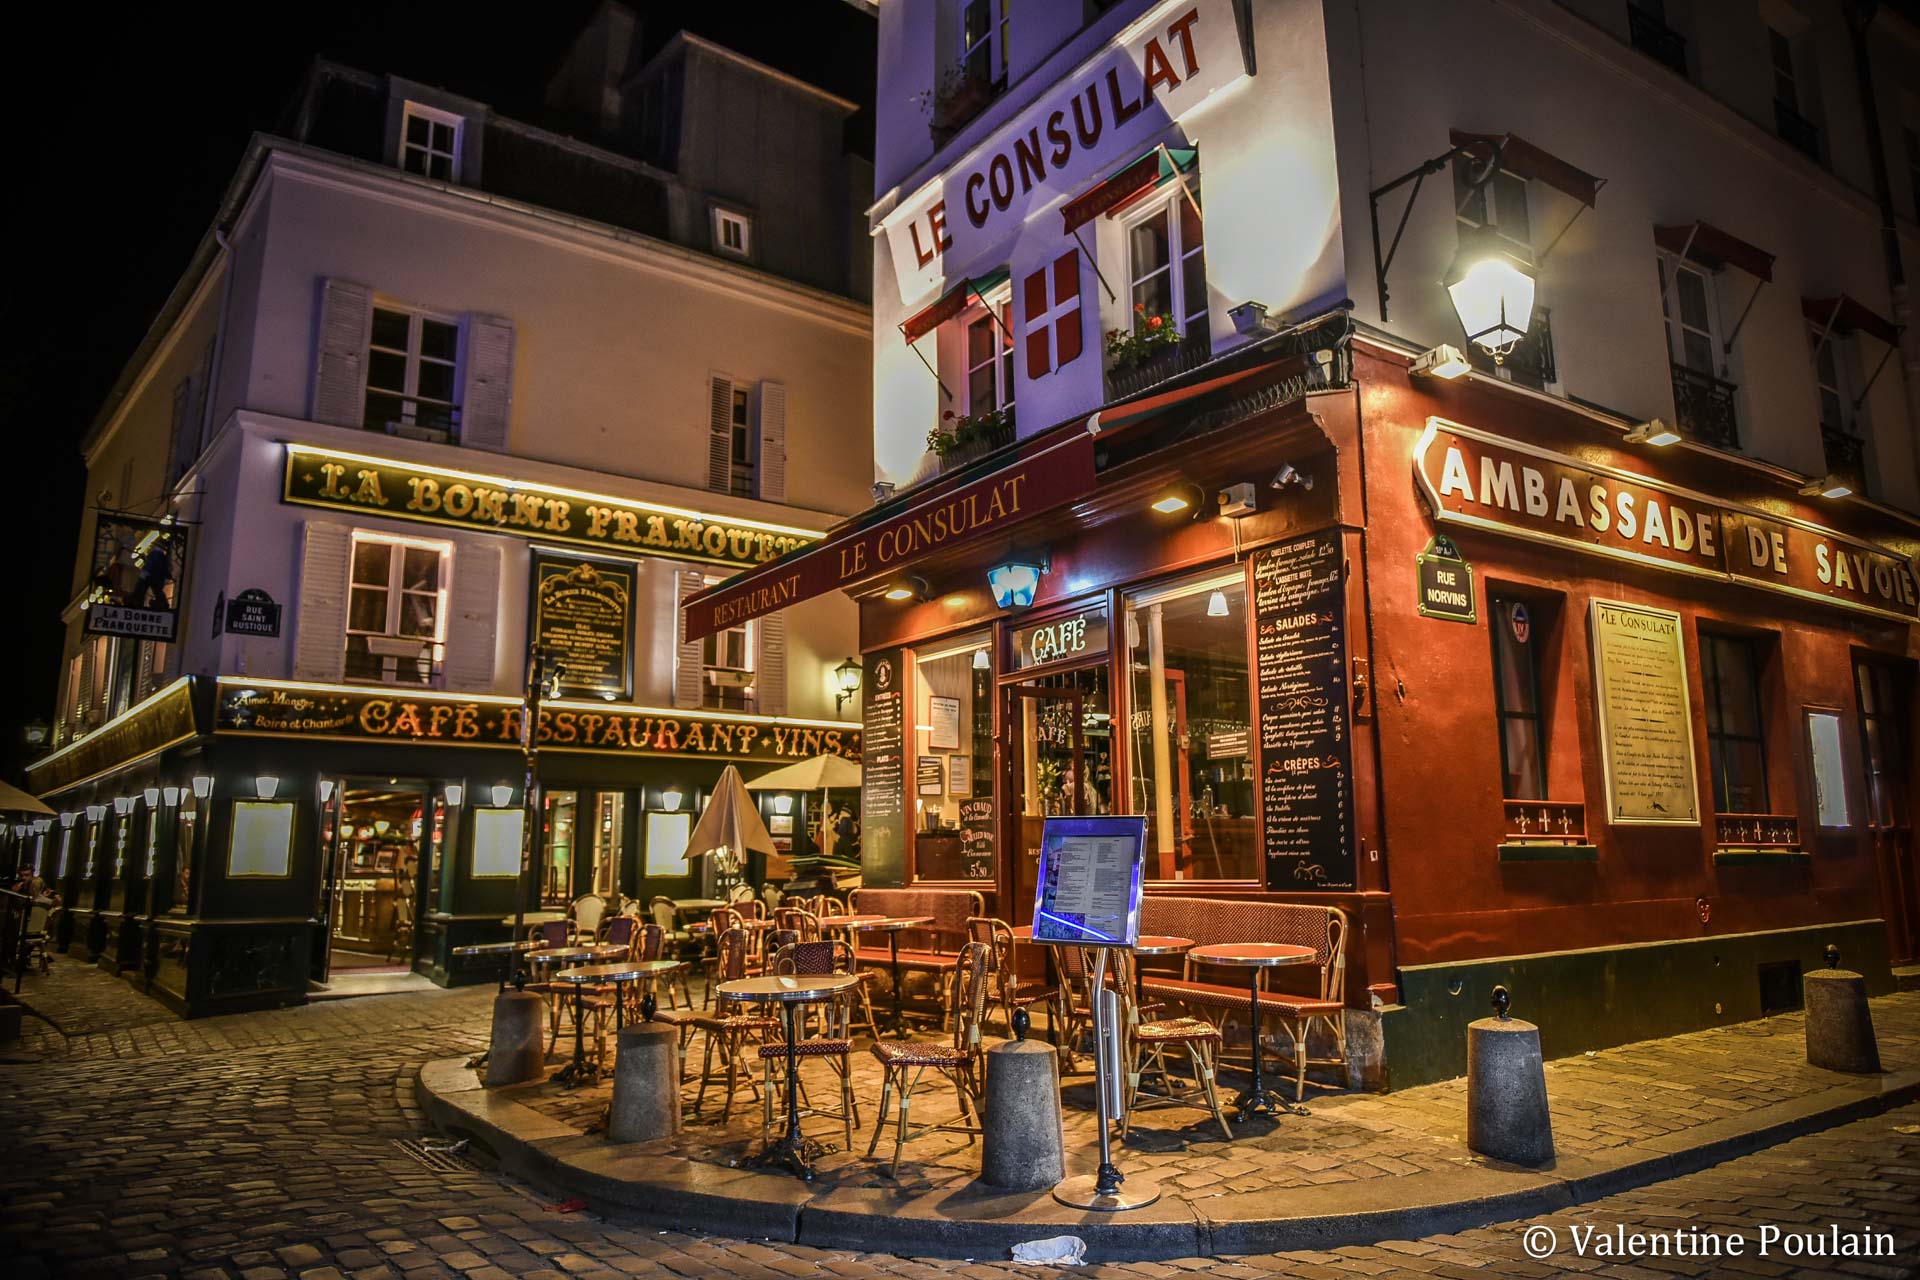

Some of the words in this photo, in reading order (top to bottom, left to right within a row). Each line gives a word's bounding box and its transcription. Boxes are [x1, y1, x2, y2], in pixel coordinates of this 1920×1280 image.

[909, 199, 953, 270] LE
[966, 8, 1200, 229] CONSULAT
[319, 463, 389, 506] LA
[406, 477, 570, 532] BONNE
[840, 541, 867, 578] LE
[878, 474, 1027, 562] CONSULAT
[1440, 446, 1715, 557] AMBASSADE
[1745, 525, 1788, 574] DE
[1815, 543, 1915, 607] SAVOIE
[1437, 571, 1456, 586] RUE
[714, 574, 801, 626] RESTAURANT
[1427, 588, 1467, 607] NORVINS
[241, 613, 266, 624] SAINT
[246, 605, 264, 615] RUE
[232, 620, 273, 632] RUSTIQUE
[1276, 613, 1317, 631] SALADES
[1605, 610, 1617, 625] LE
[1621, 612, 1671, 634] CONSULAT
[1031, 614, 1086, 661] CAFÉ
[359, 699, 481, 739] CAFÉ
[499, 707, 758, 754] RESTAURANT
[773, 727, 842, 756] VINS
[1284, 757, 1320, 771] CRÊPES
[960, 803, 972, 816] VIN
[973, 801, 992, 813] CHAUD
